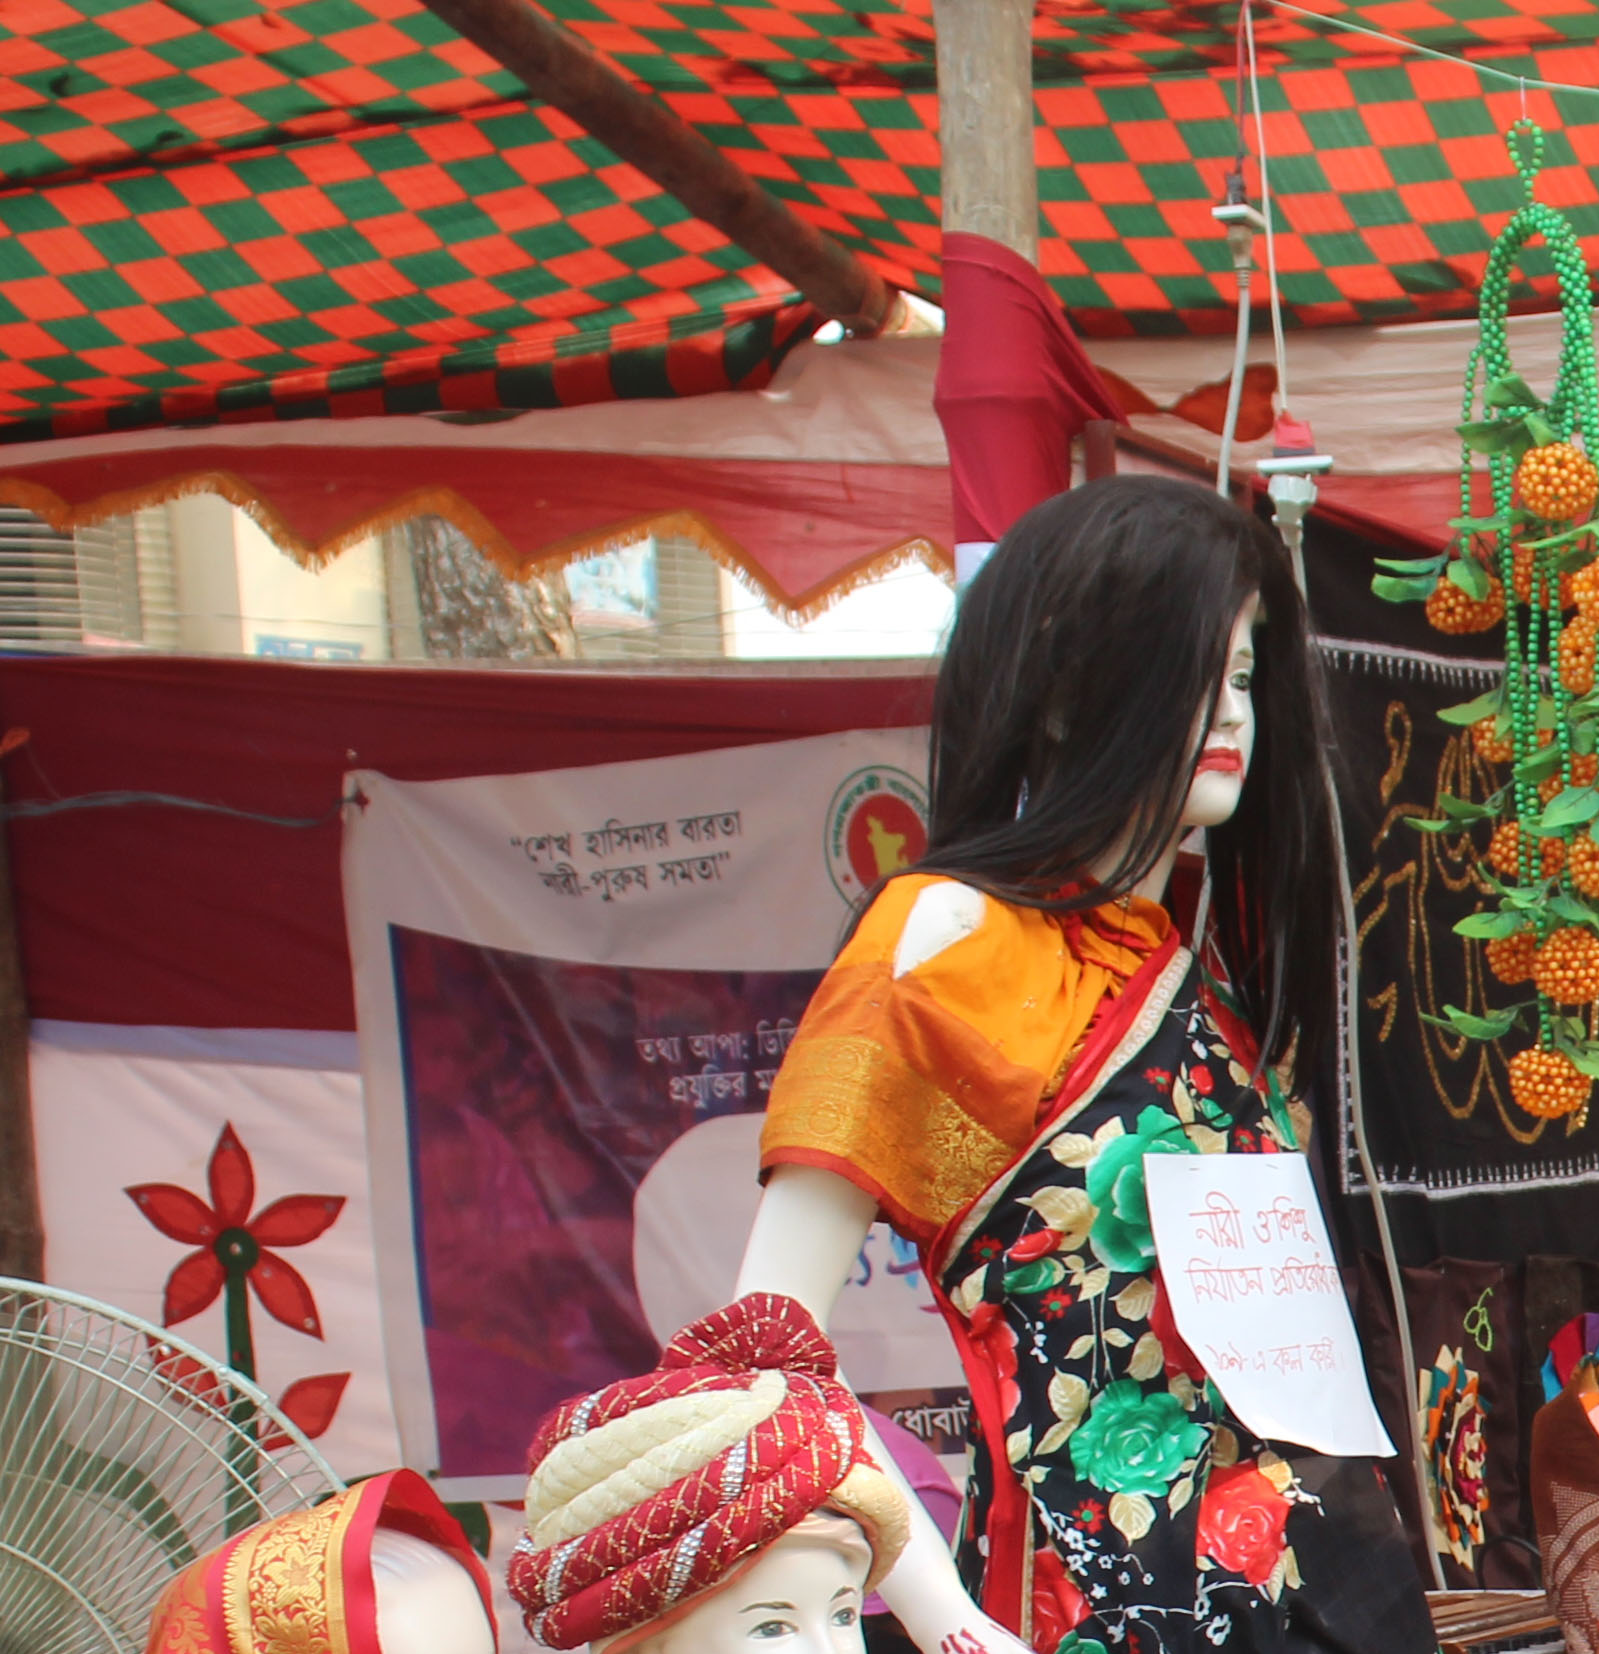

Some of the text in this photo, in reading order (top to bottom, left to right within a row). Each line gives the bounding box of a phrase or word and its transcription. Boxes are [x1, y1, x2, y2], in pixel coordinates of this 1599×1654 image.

[582, 819, 668, 856] হাসিনার
[677, 811, 742, 843] বারতা
[635, 1036, 682, 1066] তথ্য
[668, 1063, 747, 1109] প্রযুক্তির
